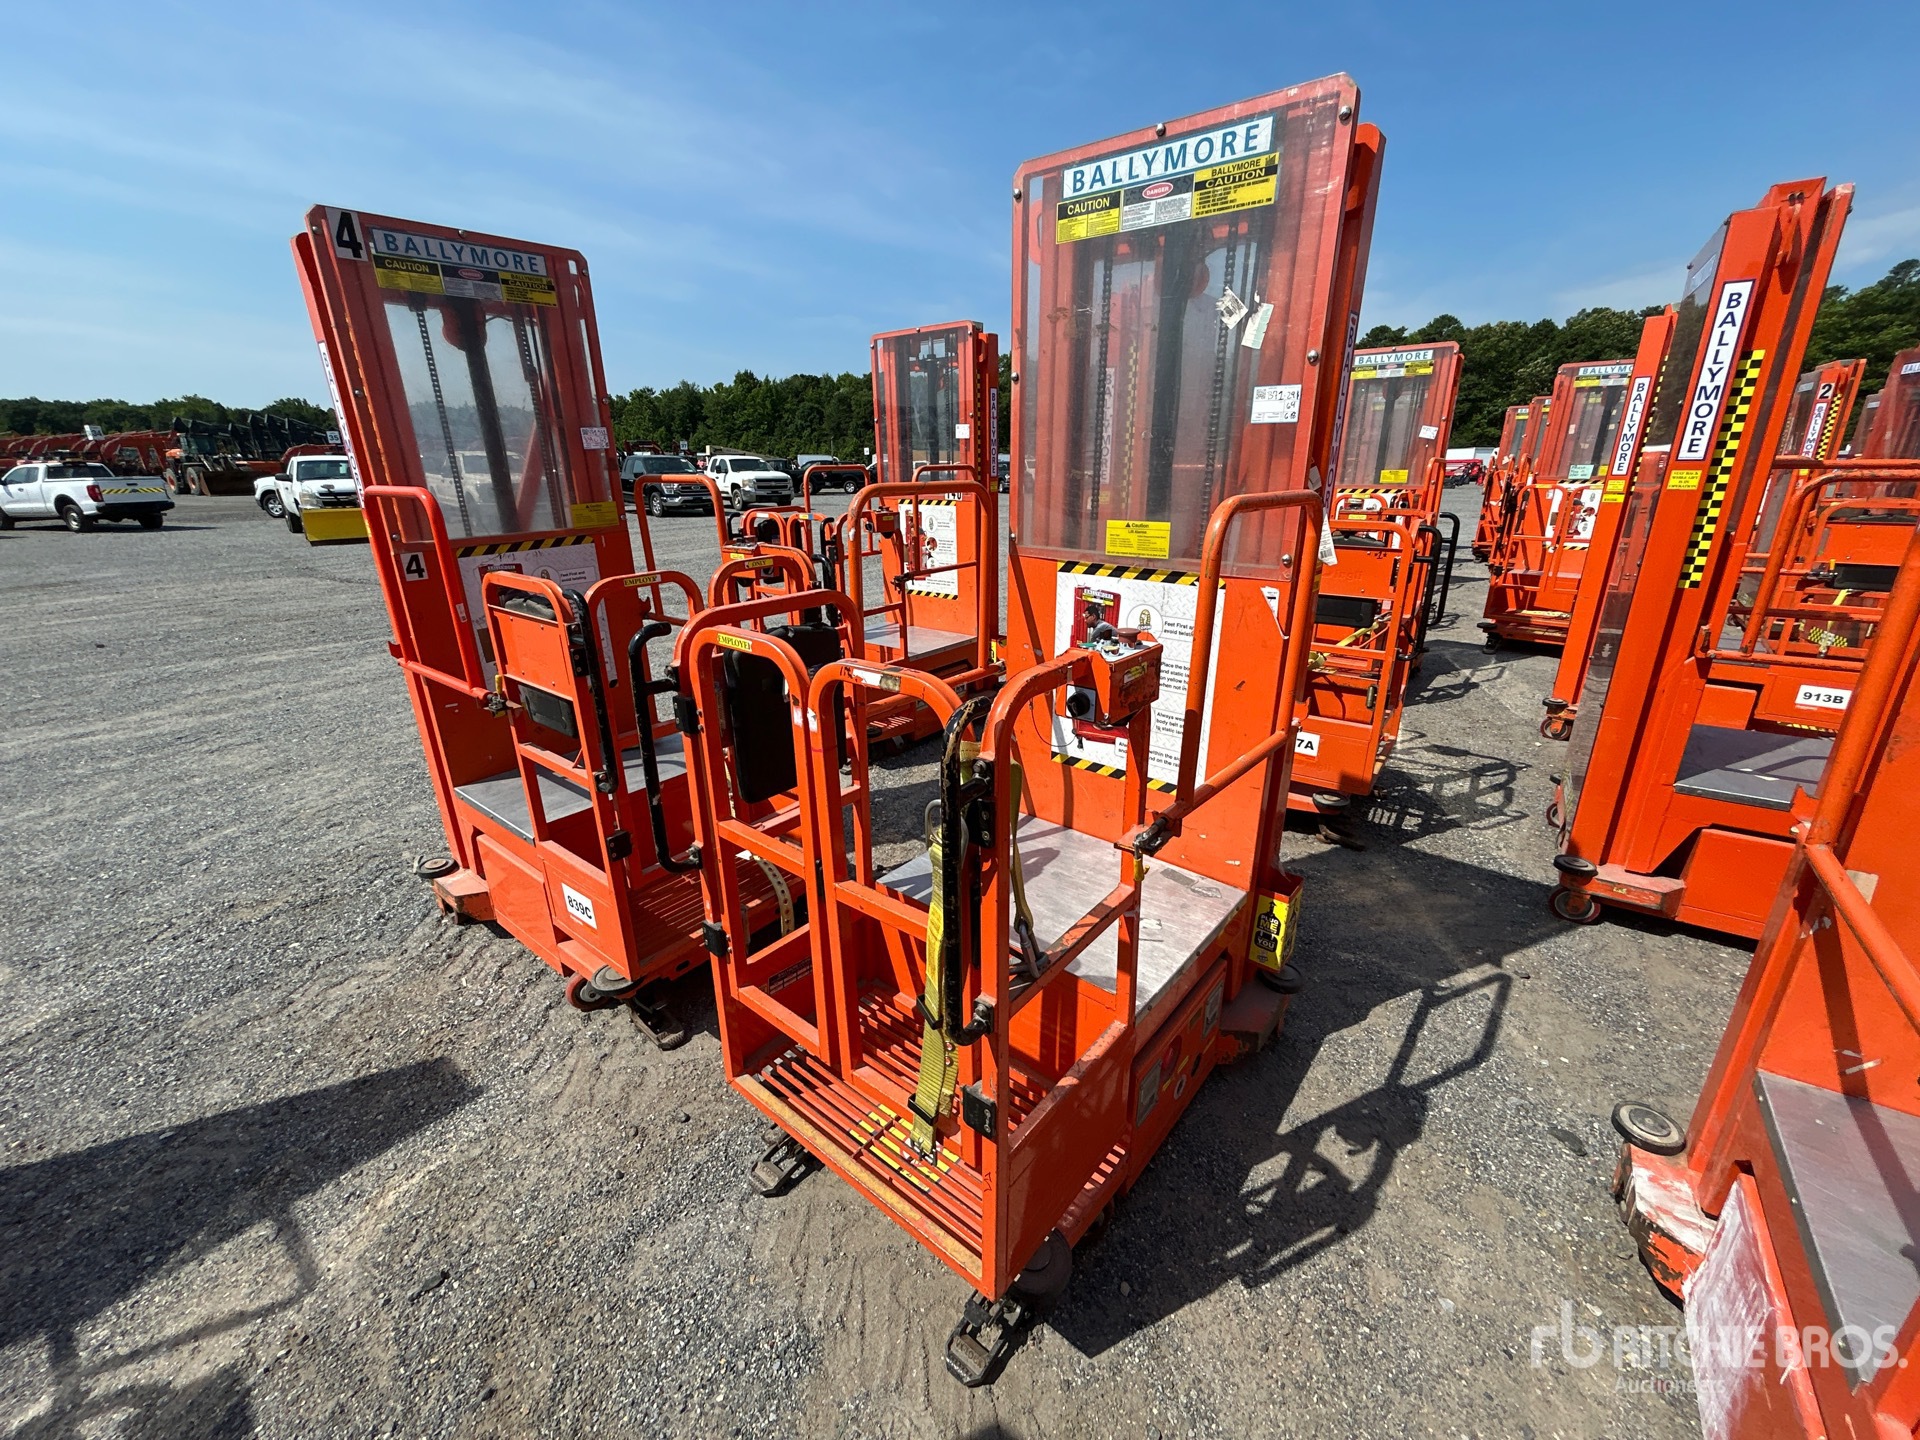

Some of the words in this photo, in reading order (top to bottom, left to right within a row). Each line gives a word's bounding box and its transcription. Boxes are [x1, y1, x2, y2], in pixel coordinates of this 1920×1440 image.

[1072, 124, 1260, 193] BALLYMORE
[1211, 159, 1261, 177] BALLYMORE
[1206, 168, 1265, 188] CAUTION
[1146, 186, 1169, 196] DANGER
[1067, 197, 1110, 215] CAUTION
[336, 211, 363, 259] 4
[383, 233, 540, 273] BALLYMORE
[385, 259, 430, 273] CAUTION
[508, 280, 548, 290] CAUTION
[1358, 351, 1429, 364] BALLYMORE
[1687, 291, 1743, 454] BALLYMORE
[1818, 383, 1833, 400] 2
[1616, 382, 1646, 472] BALLYMORE
[406, 554, 425, 579] 4
[1802, 691, 1845, 704] 913B
[567, 895, 592, 920] 839C
[1260, 914, 1279, 924] PLUG
[1260, 920, 1278, 931] ME
[1257, 938, 1275, 949] YOU
